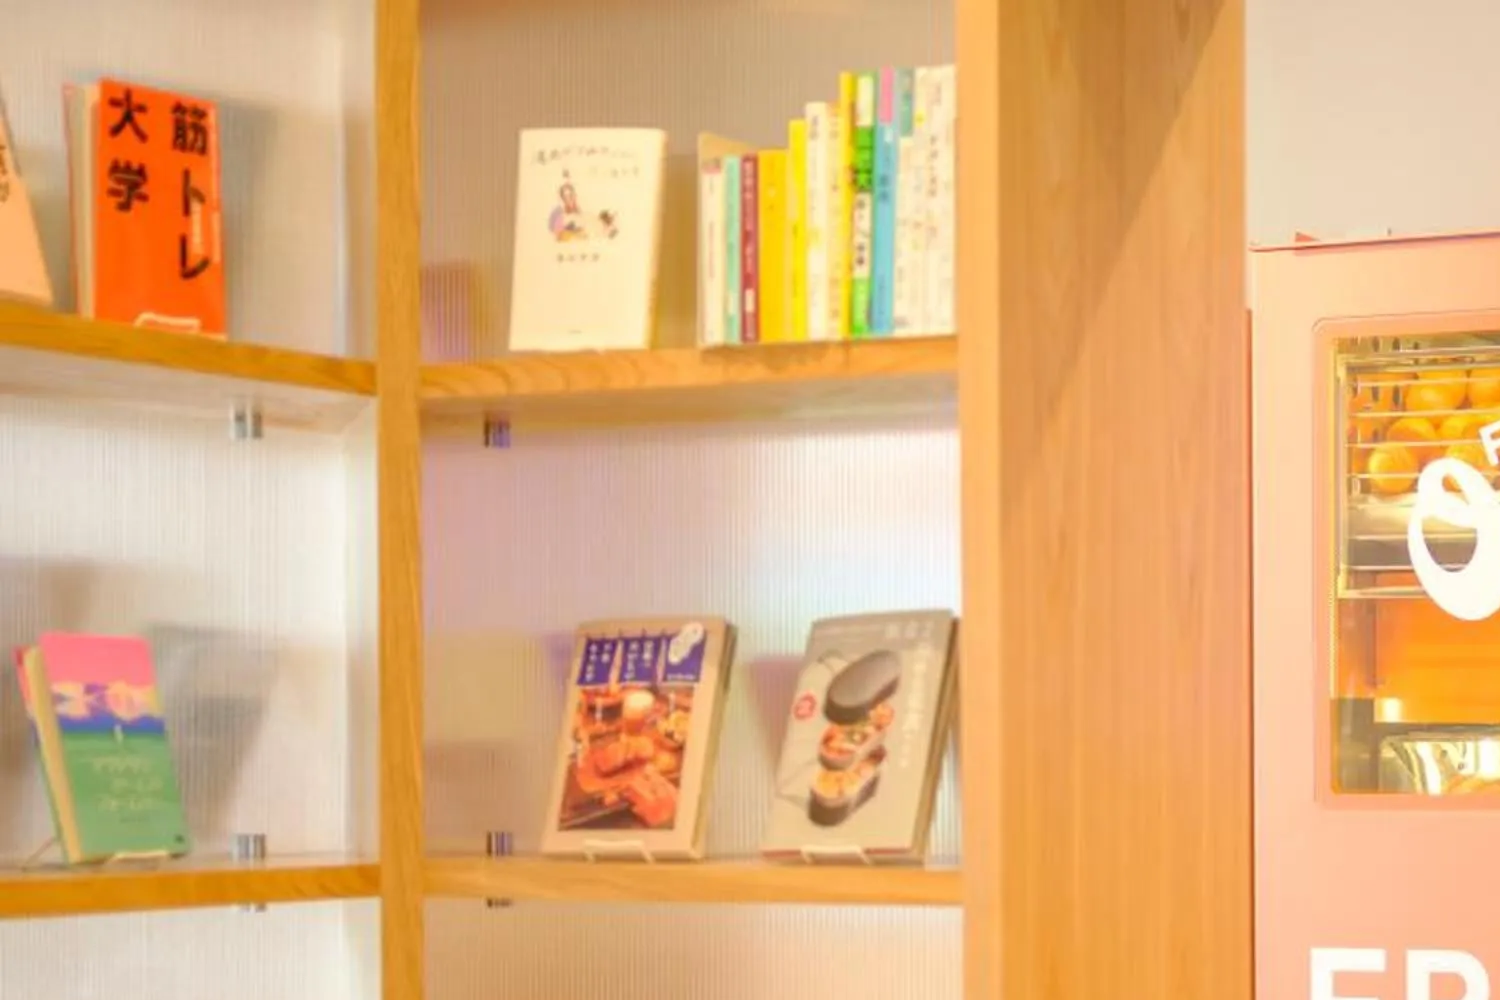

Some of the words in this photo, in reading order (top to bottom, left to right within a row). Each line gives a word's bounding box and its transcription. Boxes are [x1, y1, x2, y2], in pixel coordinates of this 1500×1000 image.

[107, 87, 149, 213] 大学
[170, 101, 210, 280] 筋トレ
